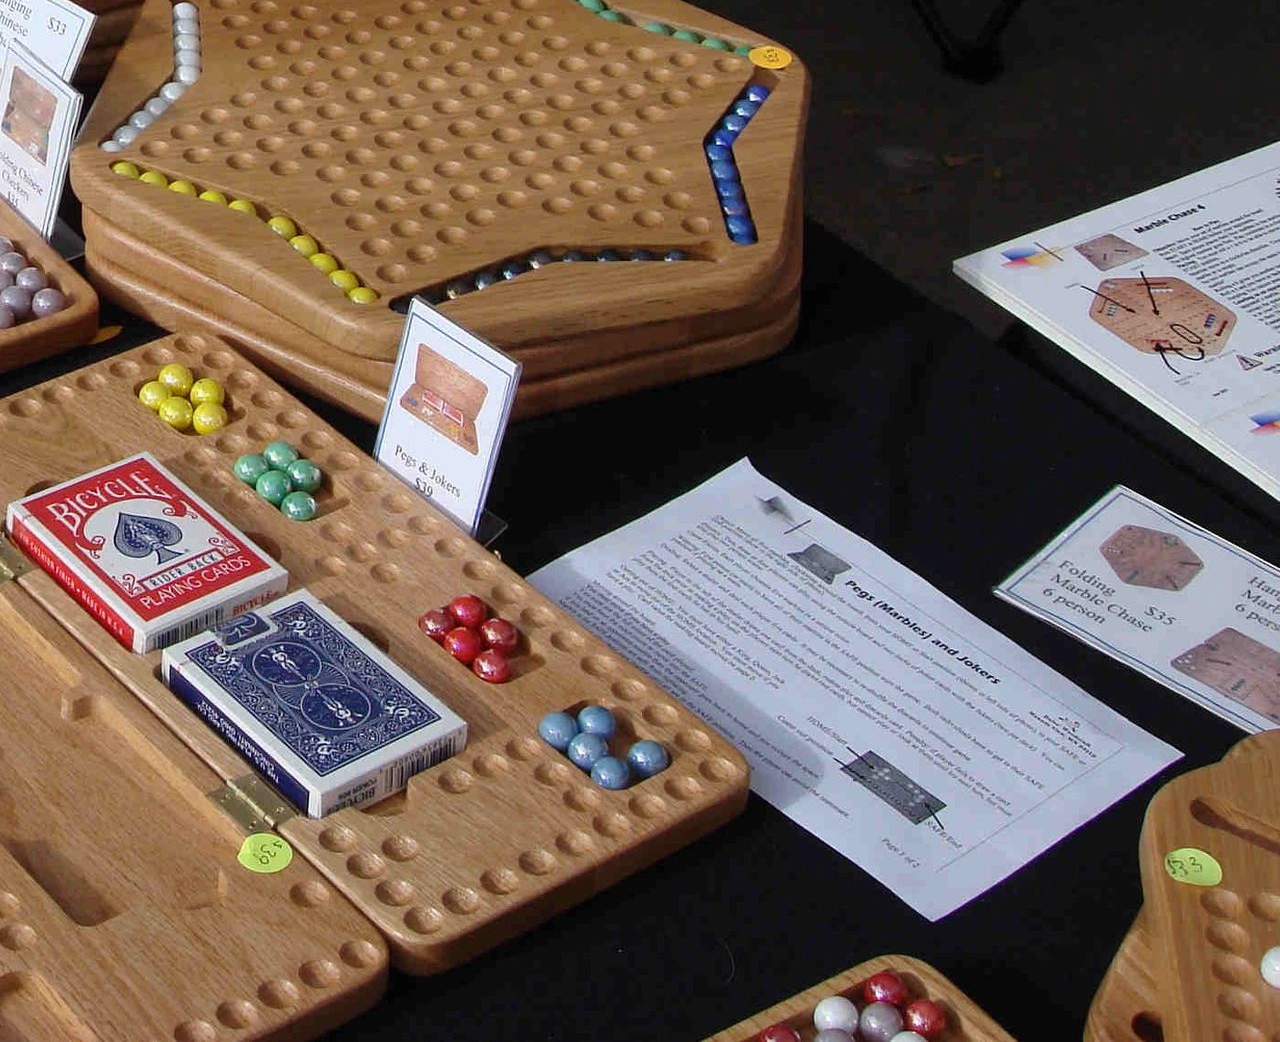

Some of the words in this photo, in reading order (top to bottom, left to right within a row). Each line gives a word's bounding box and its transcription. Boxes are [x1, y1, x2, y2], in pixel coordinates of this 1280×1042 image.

[1134, 217, 1168, 235] Marble
[1168, 208, 1199, 224] Chase
[395, 444, 418, 468] Pegs
[418, 462, 429, 475] &
[429, 468, 461, 498] Jokers
[414, 478, 434, 498] $39
[46, 471, 173, 537] BICYCLE
[140, 574, 203, 609] PLAYING
[201, 555, 251, 582] CARDS
[150, 567, 183, 587] RIDER
[190, 553, 218, 570] BACK
[1058, 560, 1116, 597] Folding
[1042, 588, 1053, 598] 6
[1052, 592, 1106, 626] person
[1050, 573, 1104, 607] Marble
[1107, 603, 1153, 633] Chase
[1144, 606, 1176, 627] $35
[1234, 603, 1245, 613] 6
[845, 580, 875, 603] Pegs
[875, 599, 931, 641] (Marbles)
[931, 637, 958, 657] and
[958, 654, 1000, 685] Jokers
